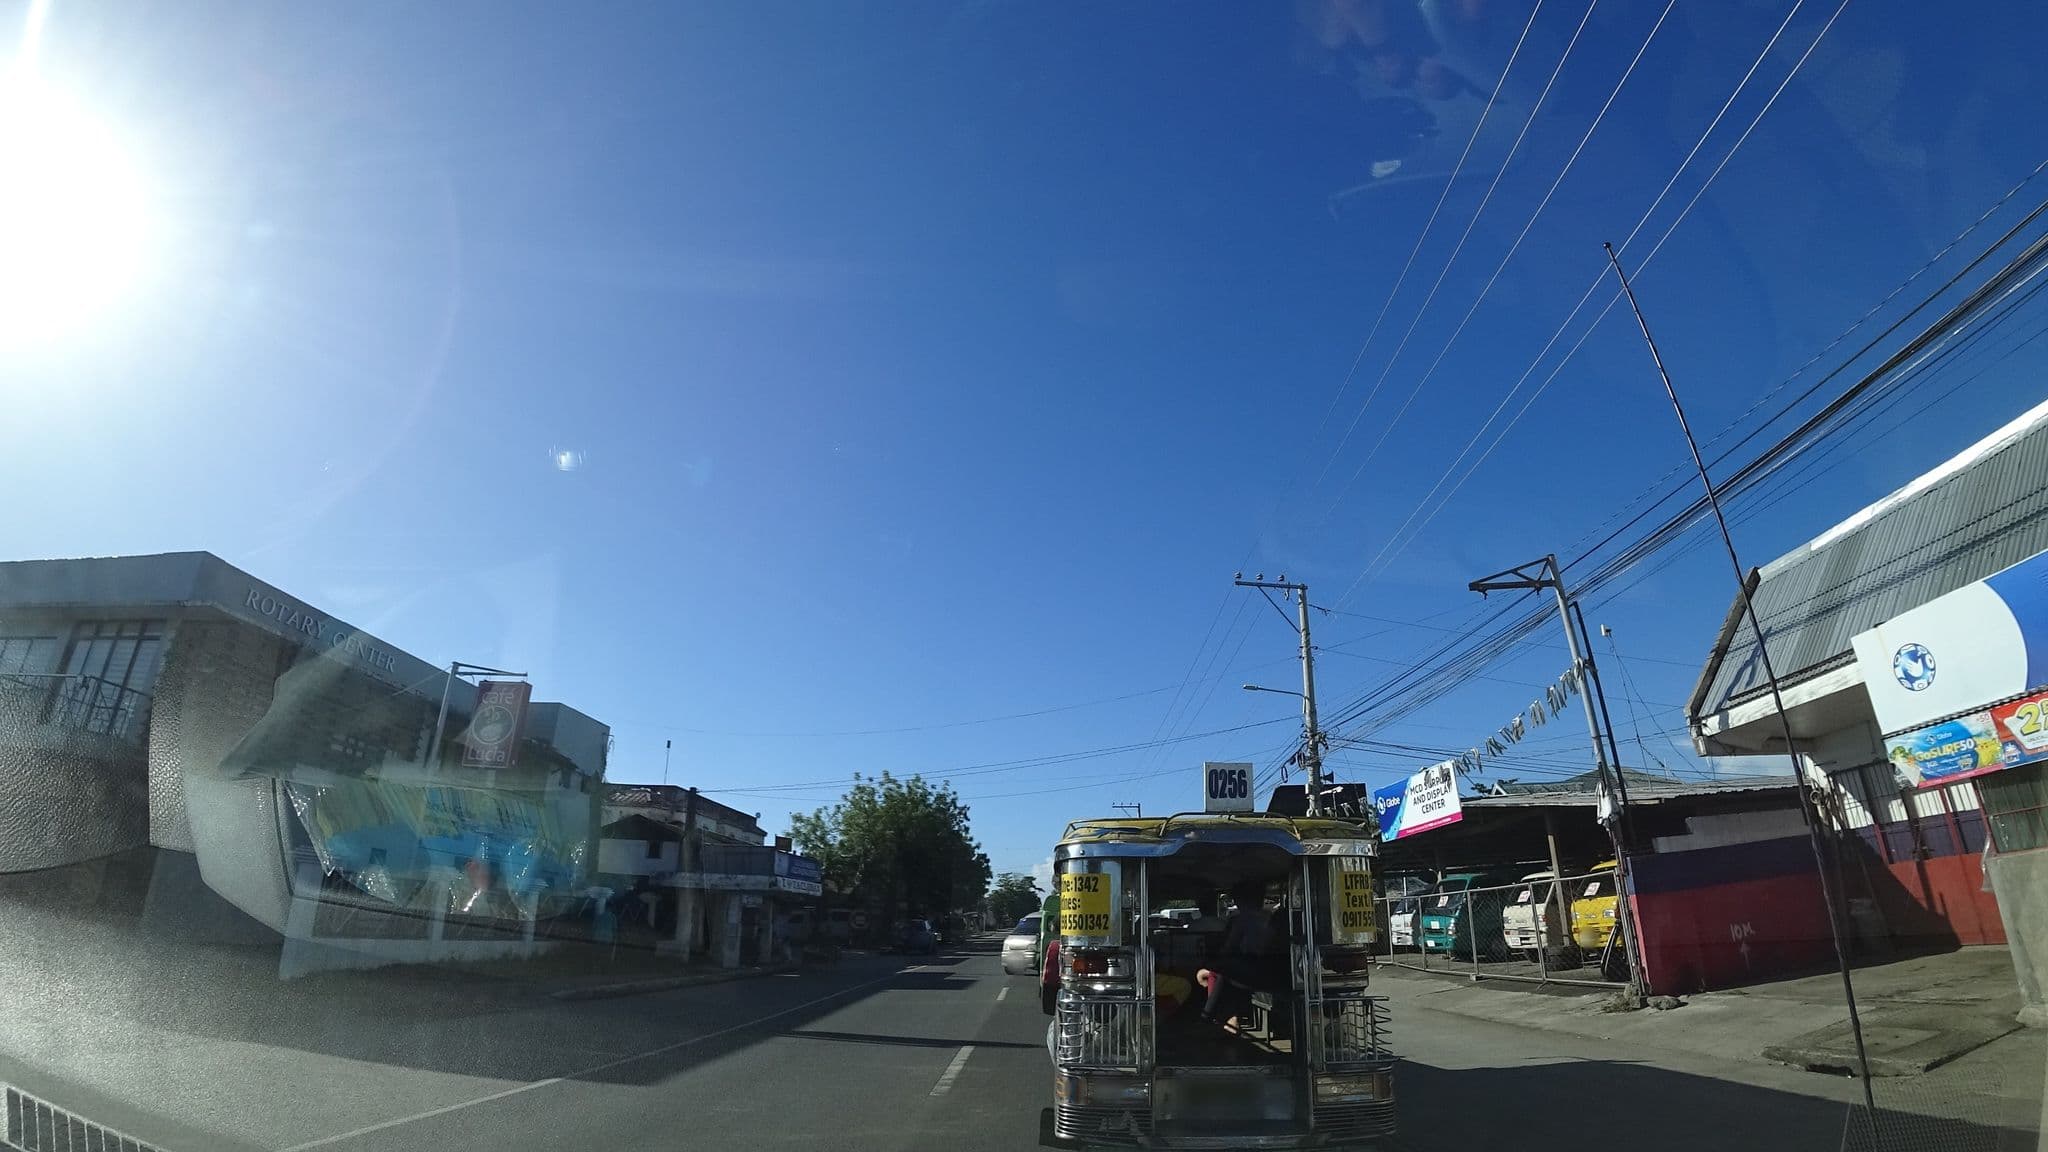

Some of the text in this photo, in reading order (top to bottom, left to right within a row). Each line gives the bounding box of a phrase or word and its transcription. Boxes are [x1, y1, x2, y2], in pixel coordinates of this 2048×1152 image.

[245, 589, 395, 673] ROTARY CENTER
[2017, 704, 2041, 735] 2
[467, 744, 505, 762] Lucia
[1916, 738, 1975, 760] GoSURF50
[1208, 768, 1248, 799] 0256
[1410, 783, 1423, 796] MCD
[1386, 796, 1401, 808] Globe
[1413, 783, 1452, 806] AND DISPLAY
[1421, 798, 1446, 814] CENTER
[1344, 873, 1369, 890] LTFRB
[1344, 891, 1369, 908] Text
